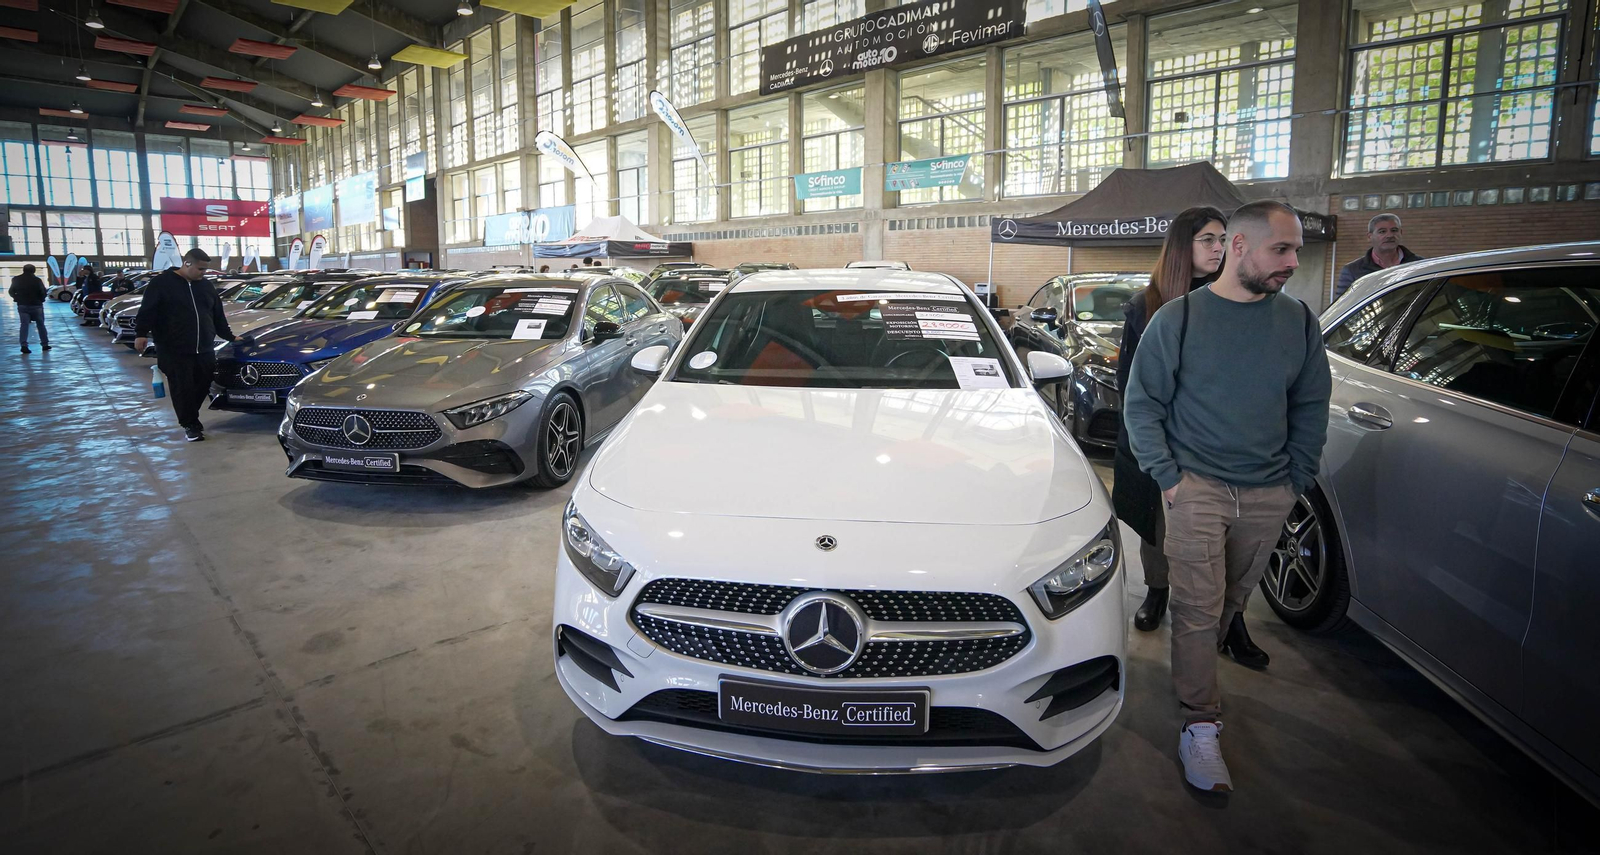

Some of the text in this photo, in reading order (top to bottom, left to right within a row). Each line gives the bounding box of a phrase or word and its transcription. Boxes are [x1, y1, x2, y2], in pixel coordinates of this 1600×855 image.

[836, 21, 938, 55] AUTOMOCIÓN
[952, 19, 1014, 46] Fevimar
[857, 49, 878, 61] auto
[852, 56, 882, 70] motor
[769, 66, 809, 81] Mercedes-Benz
[930, 160, 965, 171] Sofinco
[808, 174, 846, 188] Sofinco
[325, 456, 391, 467] Mercedes-Benz Certified
[730, 695, 911, 722] Mercedes-Benz Certified
